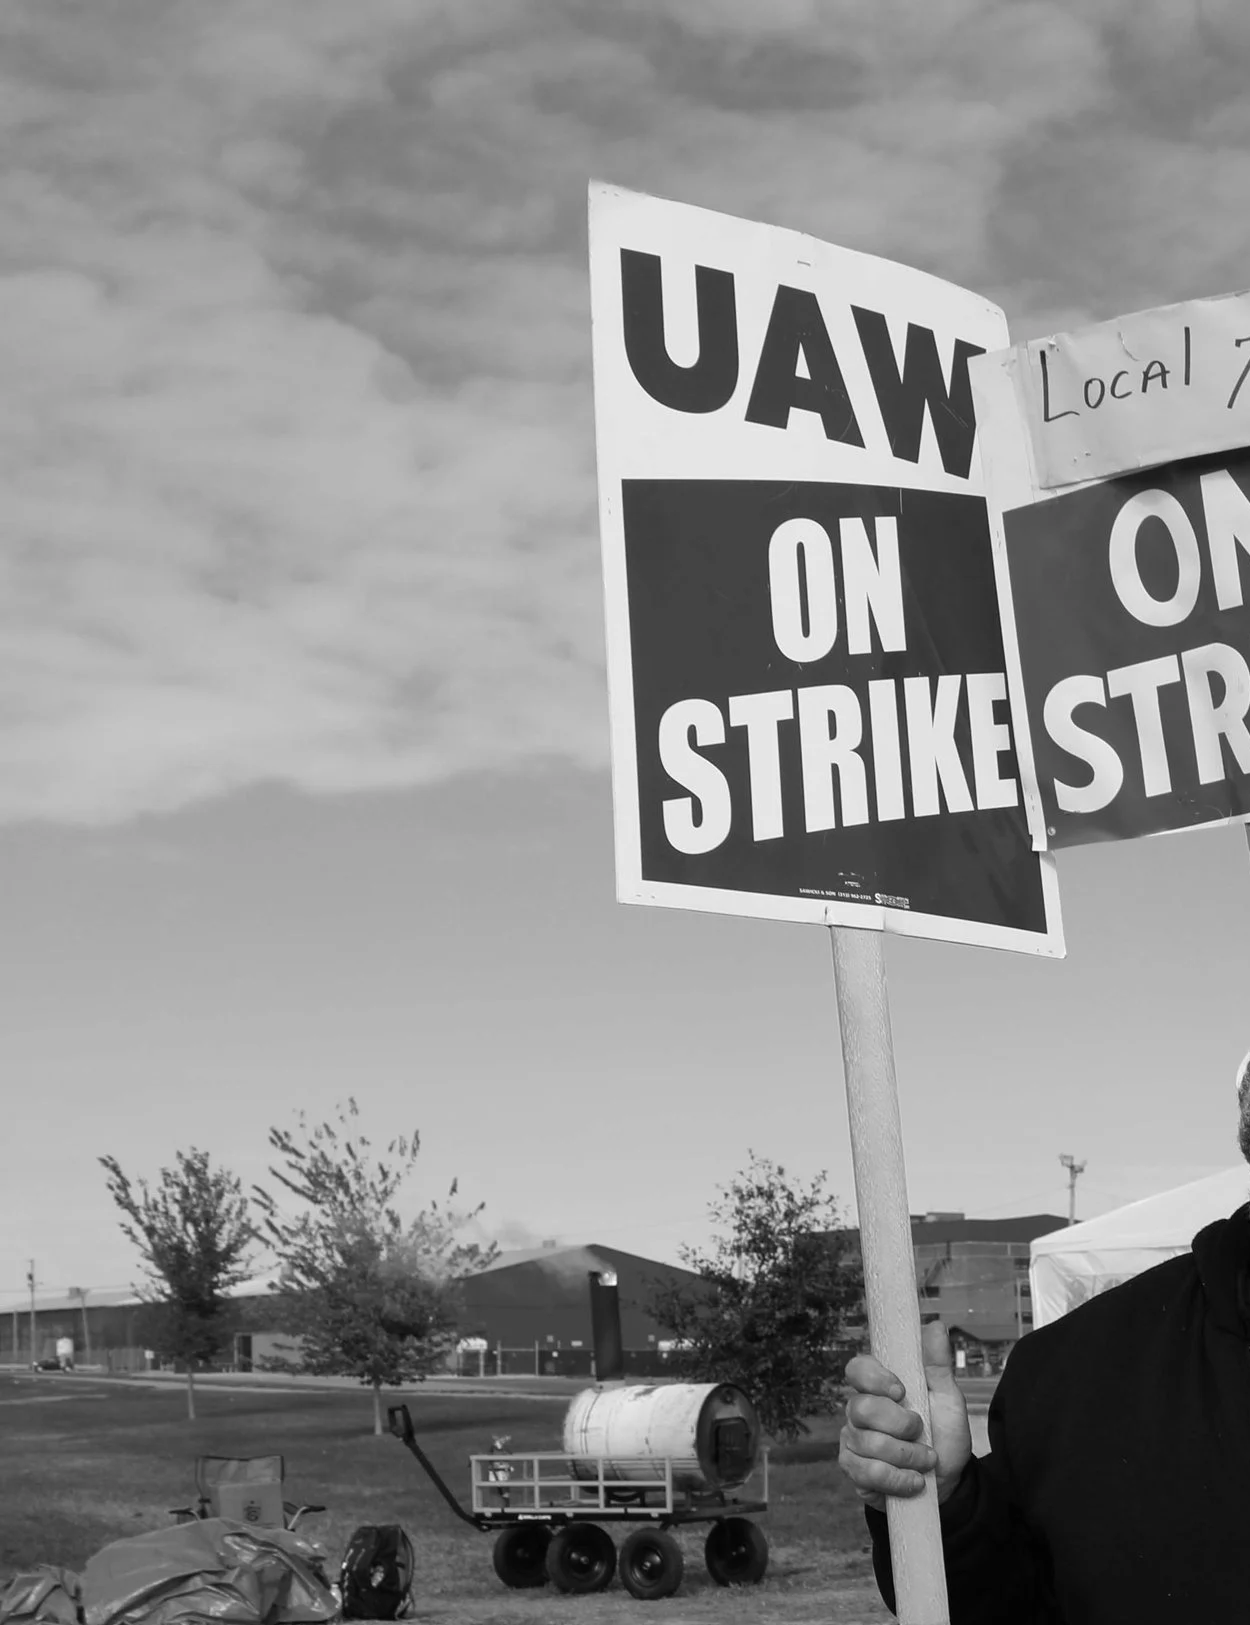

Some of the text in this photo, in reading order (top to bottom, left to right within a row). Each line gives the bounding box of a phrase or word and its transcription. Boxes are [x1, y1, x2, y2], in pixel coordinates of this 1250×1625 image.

[619, 247, 987, 480] UAW
[768, 516, 908, 663] ON
[658, 672, 1019, 855] STRIKE
